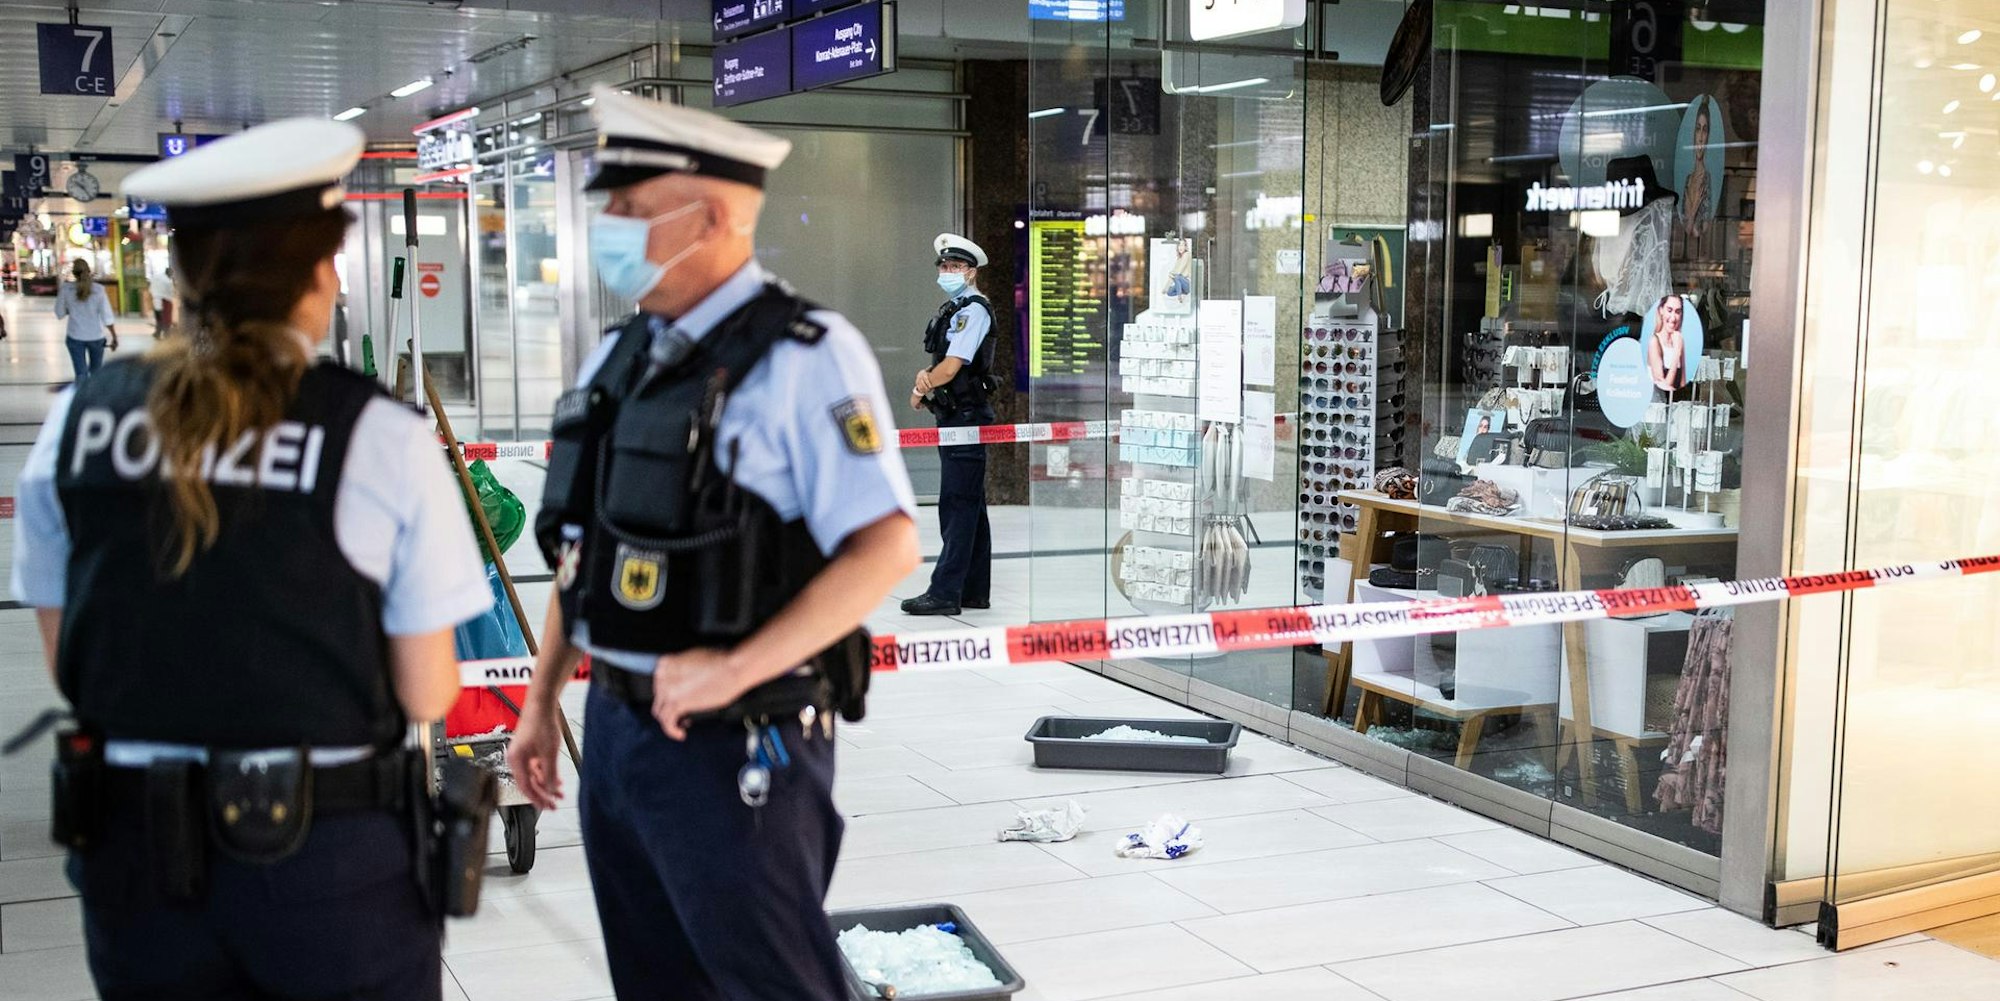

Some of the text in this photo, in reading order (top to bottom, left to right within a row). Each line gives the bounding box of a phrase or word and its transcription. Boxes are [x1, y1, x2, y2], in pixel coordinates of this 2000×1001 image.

[73, 29, 103, 72] 7
[75, 75, 106, 93] C-E
[1078, 109, 1099, 145] 7
[30, 155, 46, 177] 9
[71, 407, 325, 494] POIZEI
[1022, 619, 1239, 656] POLIZEIABSPERRUNG
